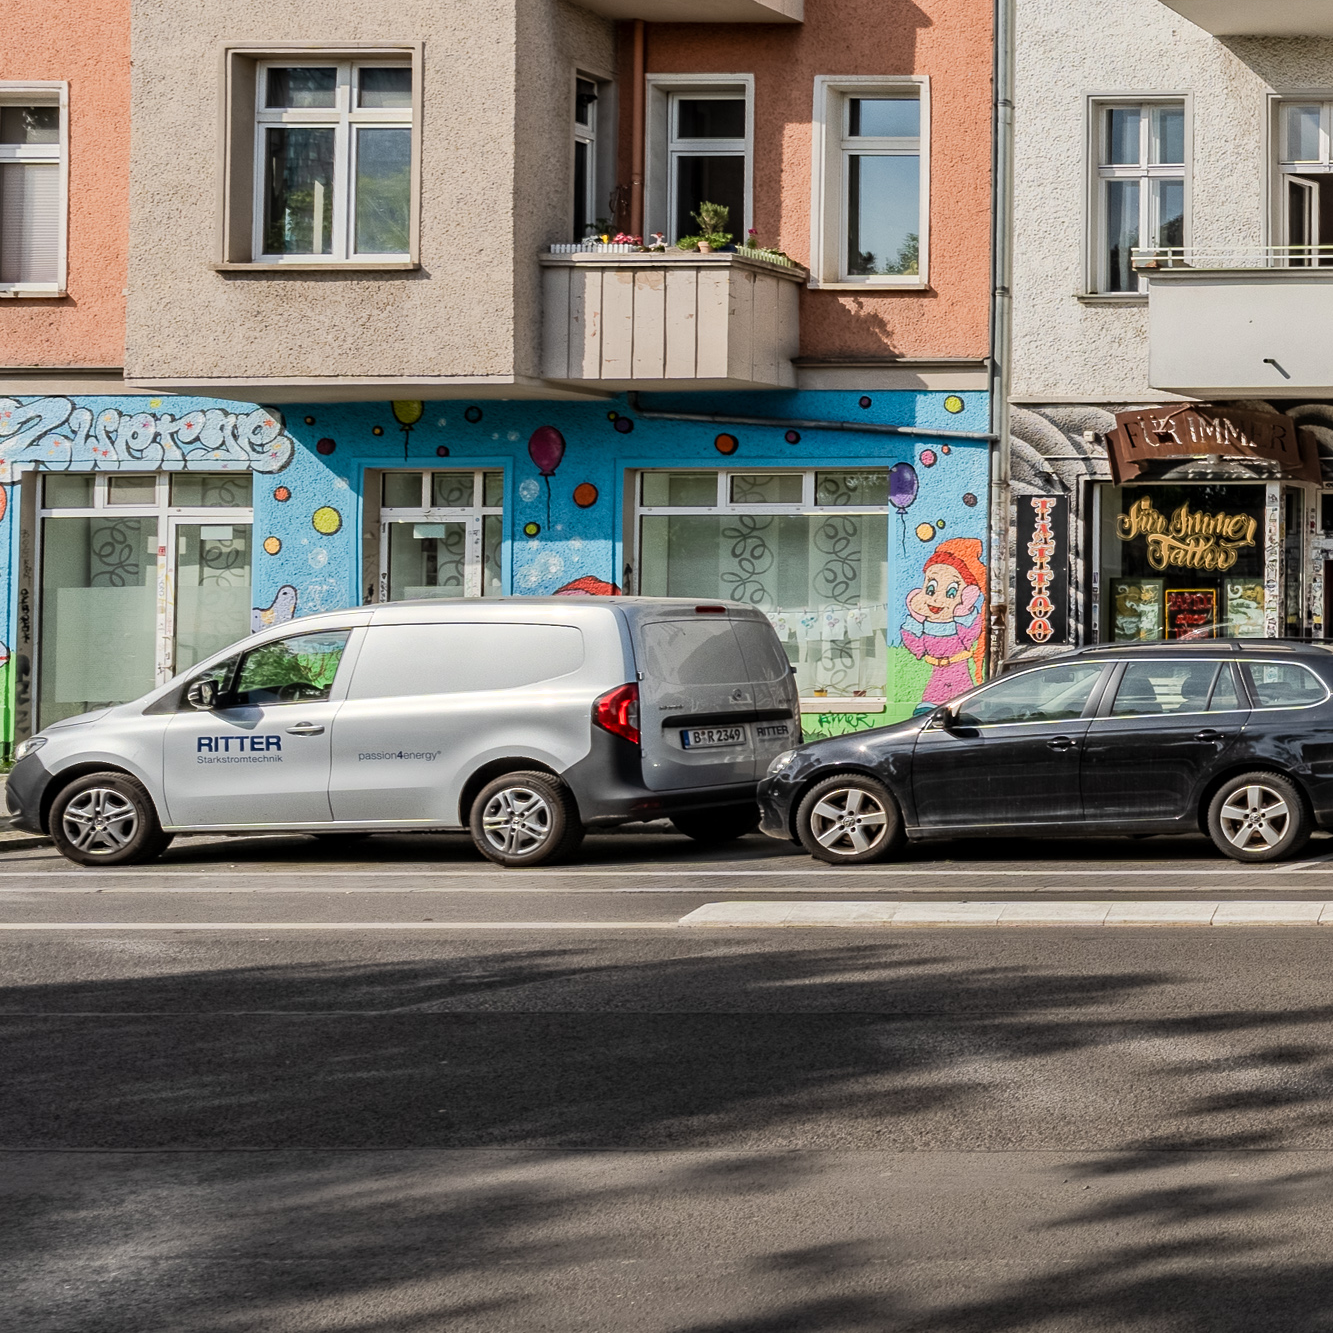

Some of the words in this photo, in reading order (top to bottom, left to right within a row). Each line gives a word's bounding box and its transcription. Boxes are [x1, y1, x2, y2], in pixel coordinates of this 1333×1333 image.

[1124, 416, 1183, 448] FÜR
[1026, 497, 1057, 643] TATTOO
[693, 731, 702, 744] B
[708, 730, 715, 743] R
[717, 729, 741, 743] 2349
[757, 726, 789, 737] RITTER
[197, 735, 282, 752] RITTER
[197, 755, 283, 764] Starkstromtechnik
